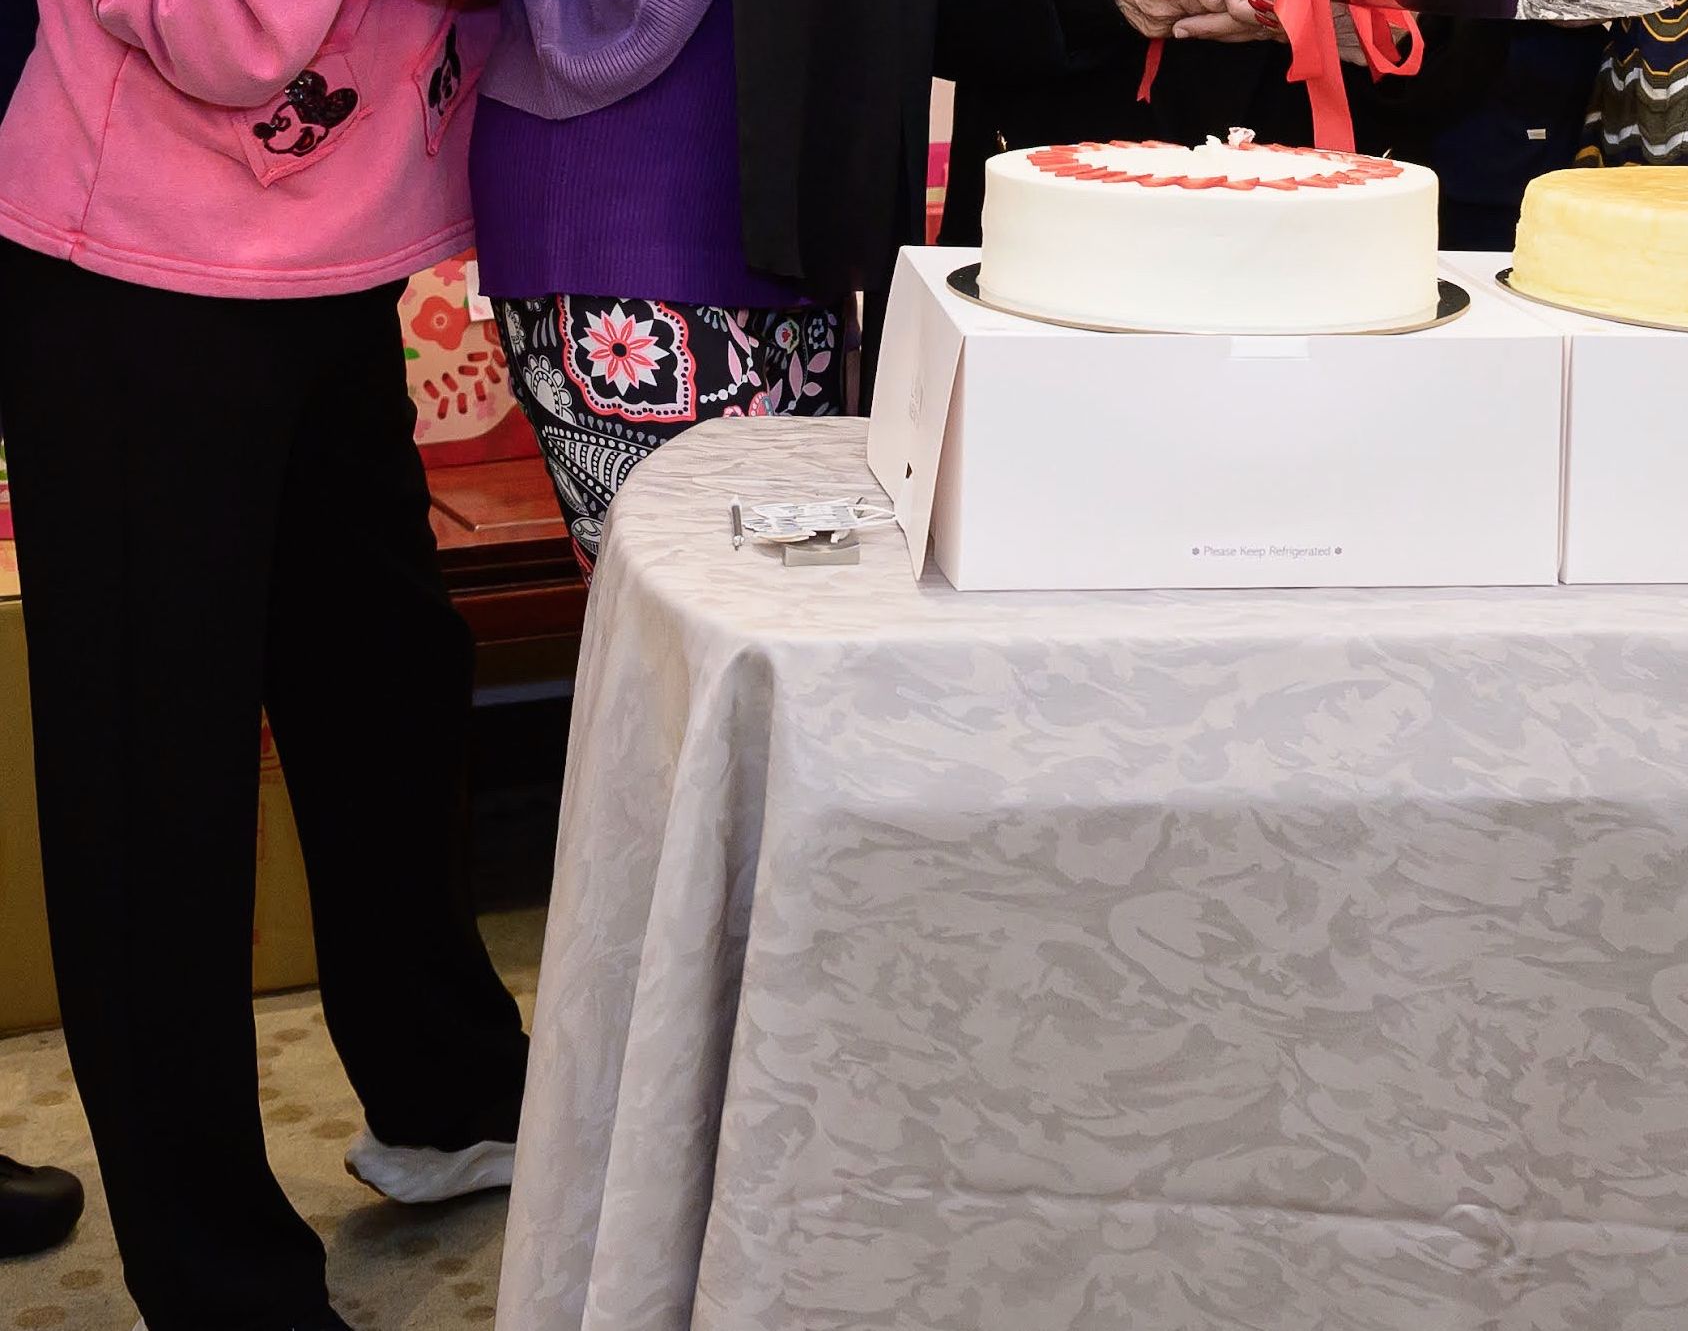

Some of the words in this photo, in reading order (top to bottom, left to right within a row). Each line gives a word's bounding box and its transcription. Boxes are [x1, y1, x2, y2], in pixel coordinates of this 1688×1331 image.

[1204, 545, 1236, 556] Please
[1240, 545, 1266, 557] Keep
[1269, 545, 1331, 557] Refrigerated
